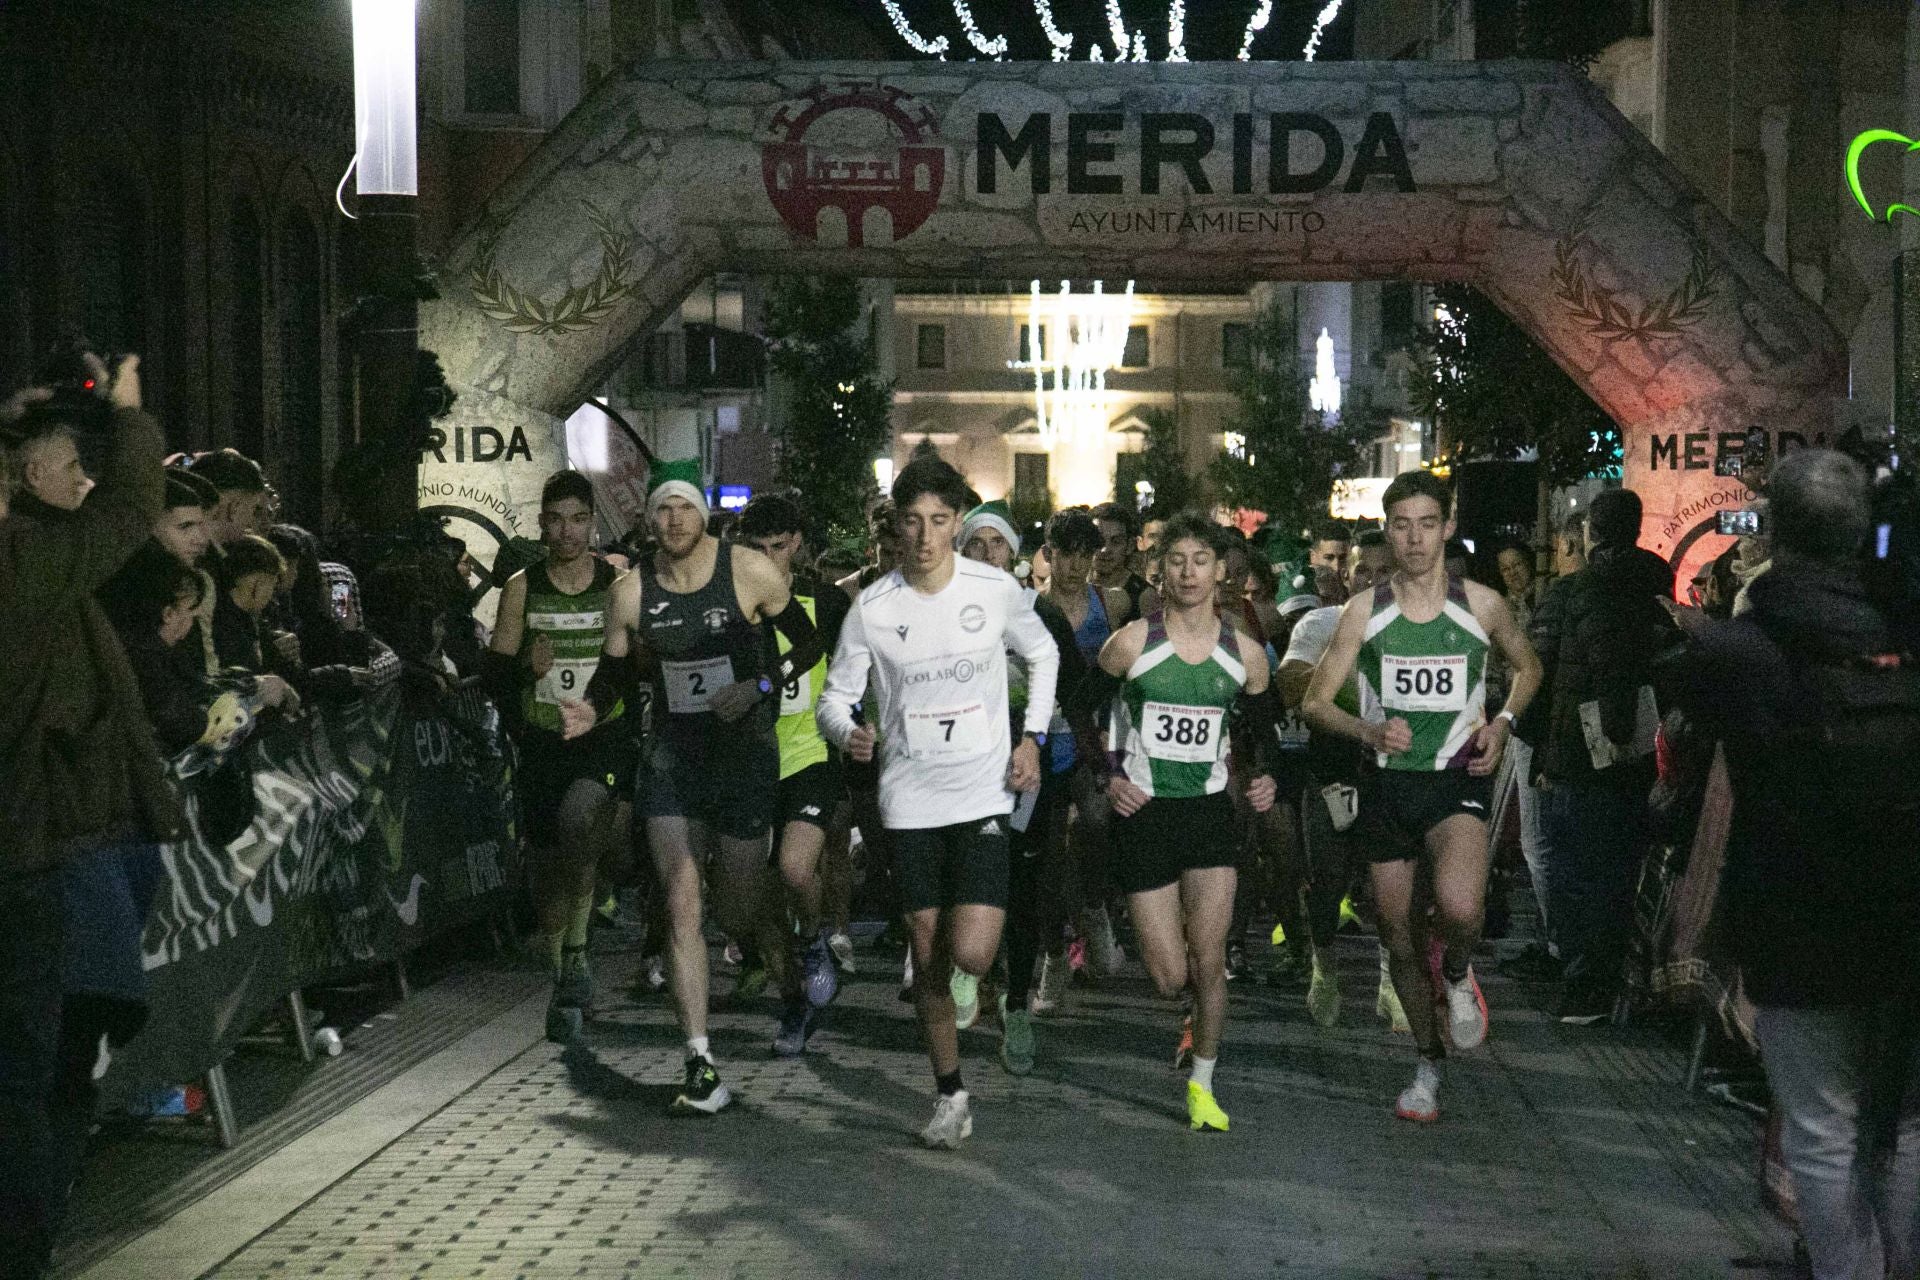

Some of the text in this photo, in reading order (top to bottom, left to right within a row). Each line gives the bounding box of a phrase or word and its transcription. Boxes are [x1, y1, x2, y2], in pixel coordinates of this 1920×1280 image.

[1069, 211, 1325, 234] AYUNTAMIENTO
[459, 485, 522, 534] MUNDIAL
[1664, 488, 1757, 539] PATRIMONIO
[561, 669, 575, 691] 9
[689, 673, 706, 695] 2
[1396, 668, 1453, 696] 508
[939, 719, 955, 742] 7
[1155, 714, 1210, 746] 388
